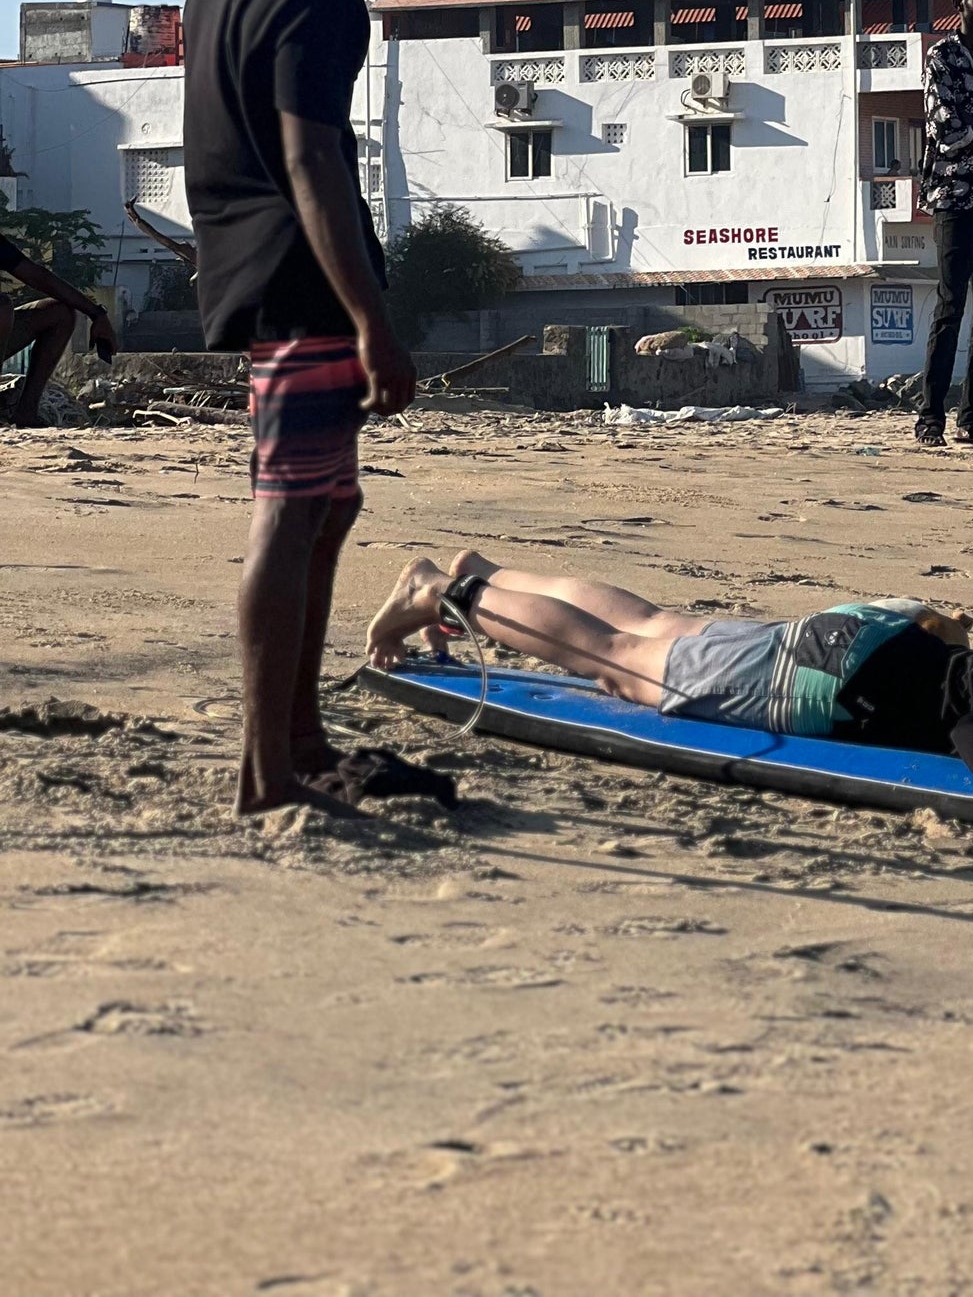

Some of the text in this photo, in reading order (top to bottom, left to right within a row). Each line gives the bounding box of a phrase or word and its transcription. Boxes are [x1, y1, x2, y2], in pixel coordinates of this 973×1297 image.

[683, 227, 779, 245] SEASHORE
[748, 245, 842, 261] RESTAURANT
[773, 290, 834, 305] MUMU
[873, 290, 910, 304] MUMU
[776, 306, 841, 329] URF
[872, 307, 911, 328] SURF
